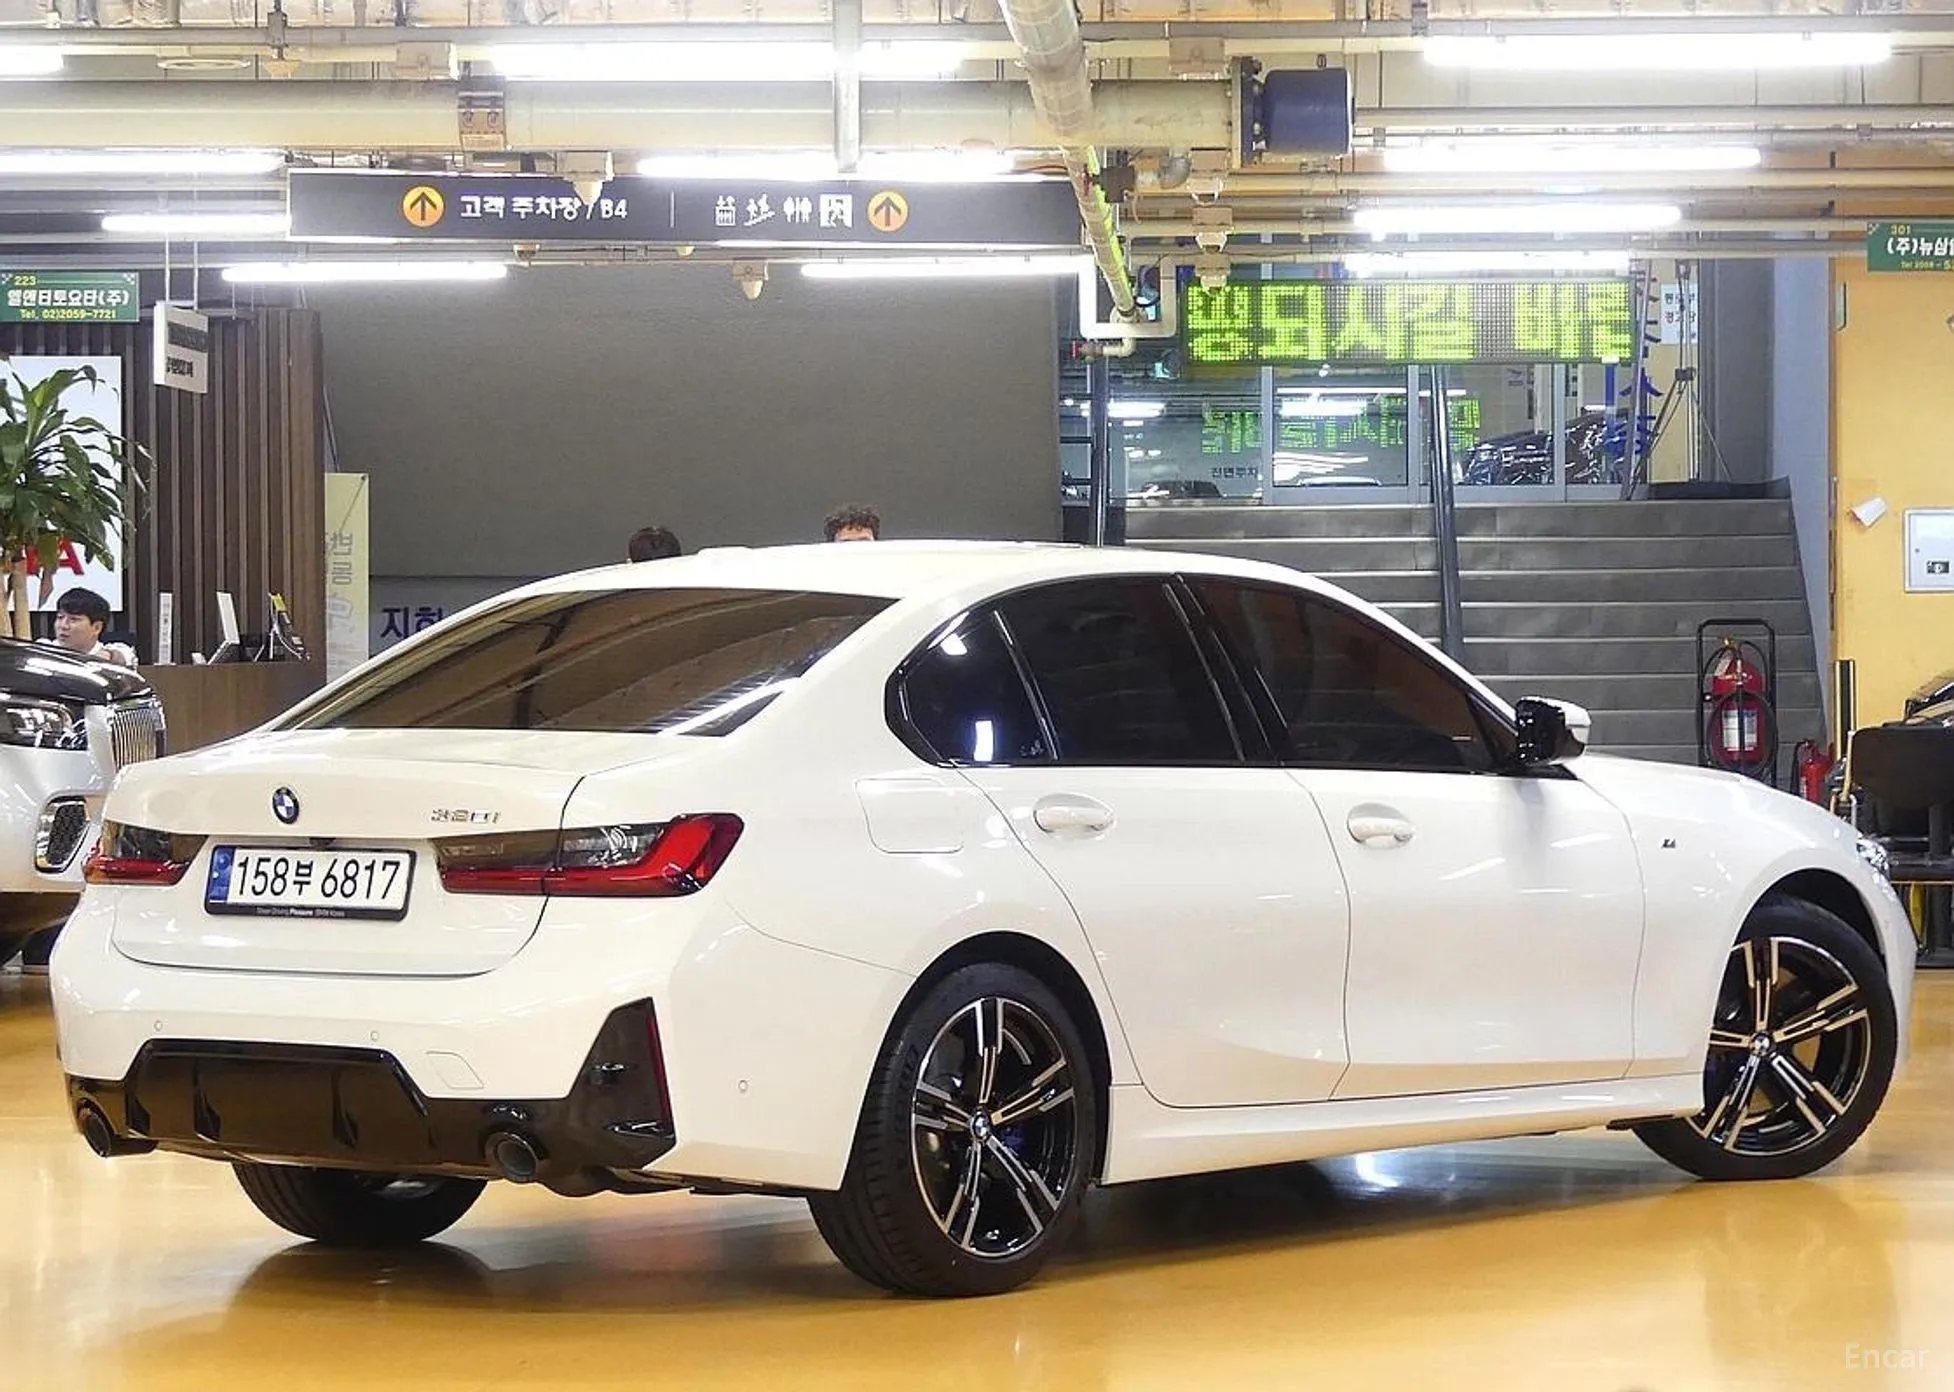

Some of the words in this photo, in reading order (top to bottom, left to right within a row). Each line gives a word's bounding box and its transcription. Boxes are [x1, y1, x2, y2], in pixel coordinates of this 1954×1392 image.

[460, 195, 505, 218] 고객
[512, 195, 581, 220] 주차장
[600, 198, 628, 219] B4
[14, 275, 37, 286] 223
[237, 855, 314, 897] 158부
[320, 858, 402, 900] 6817
